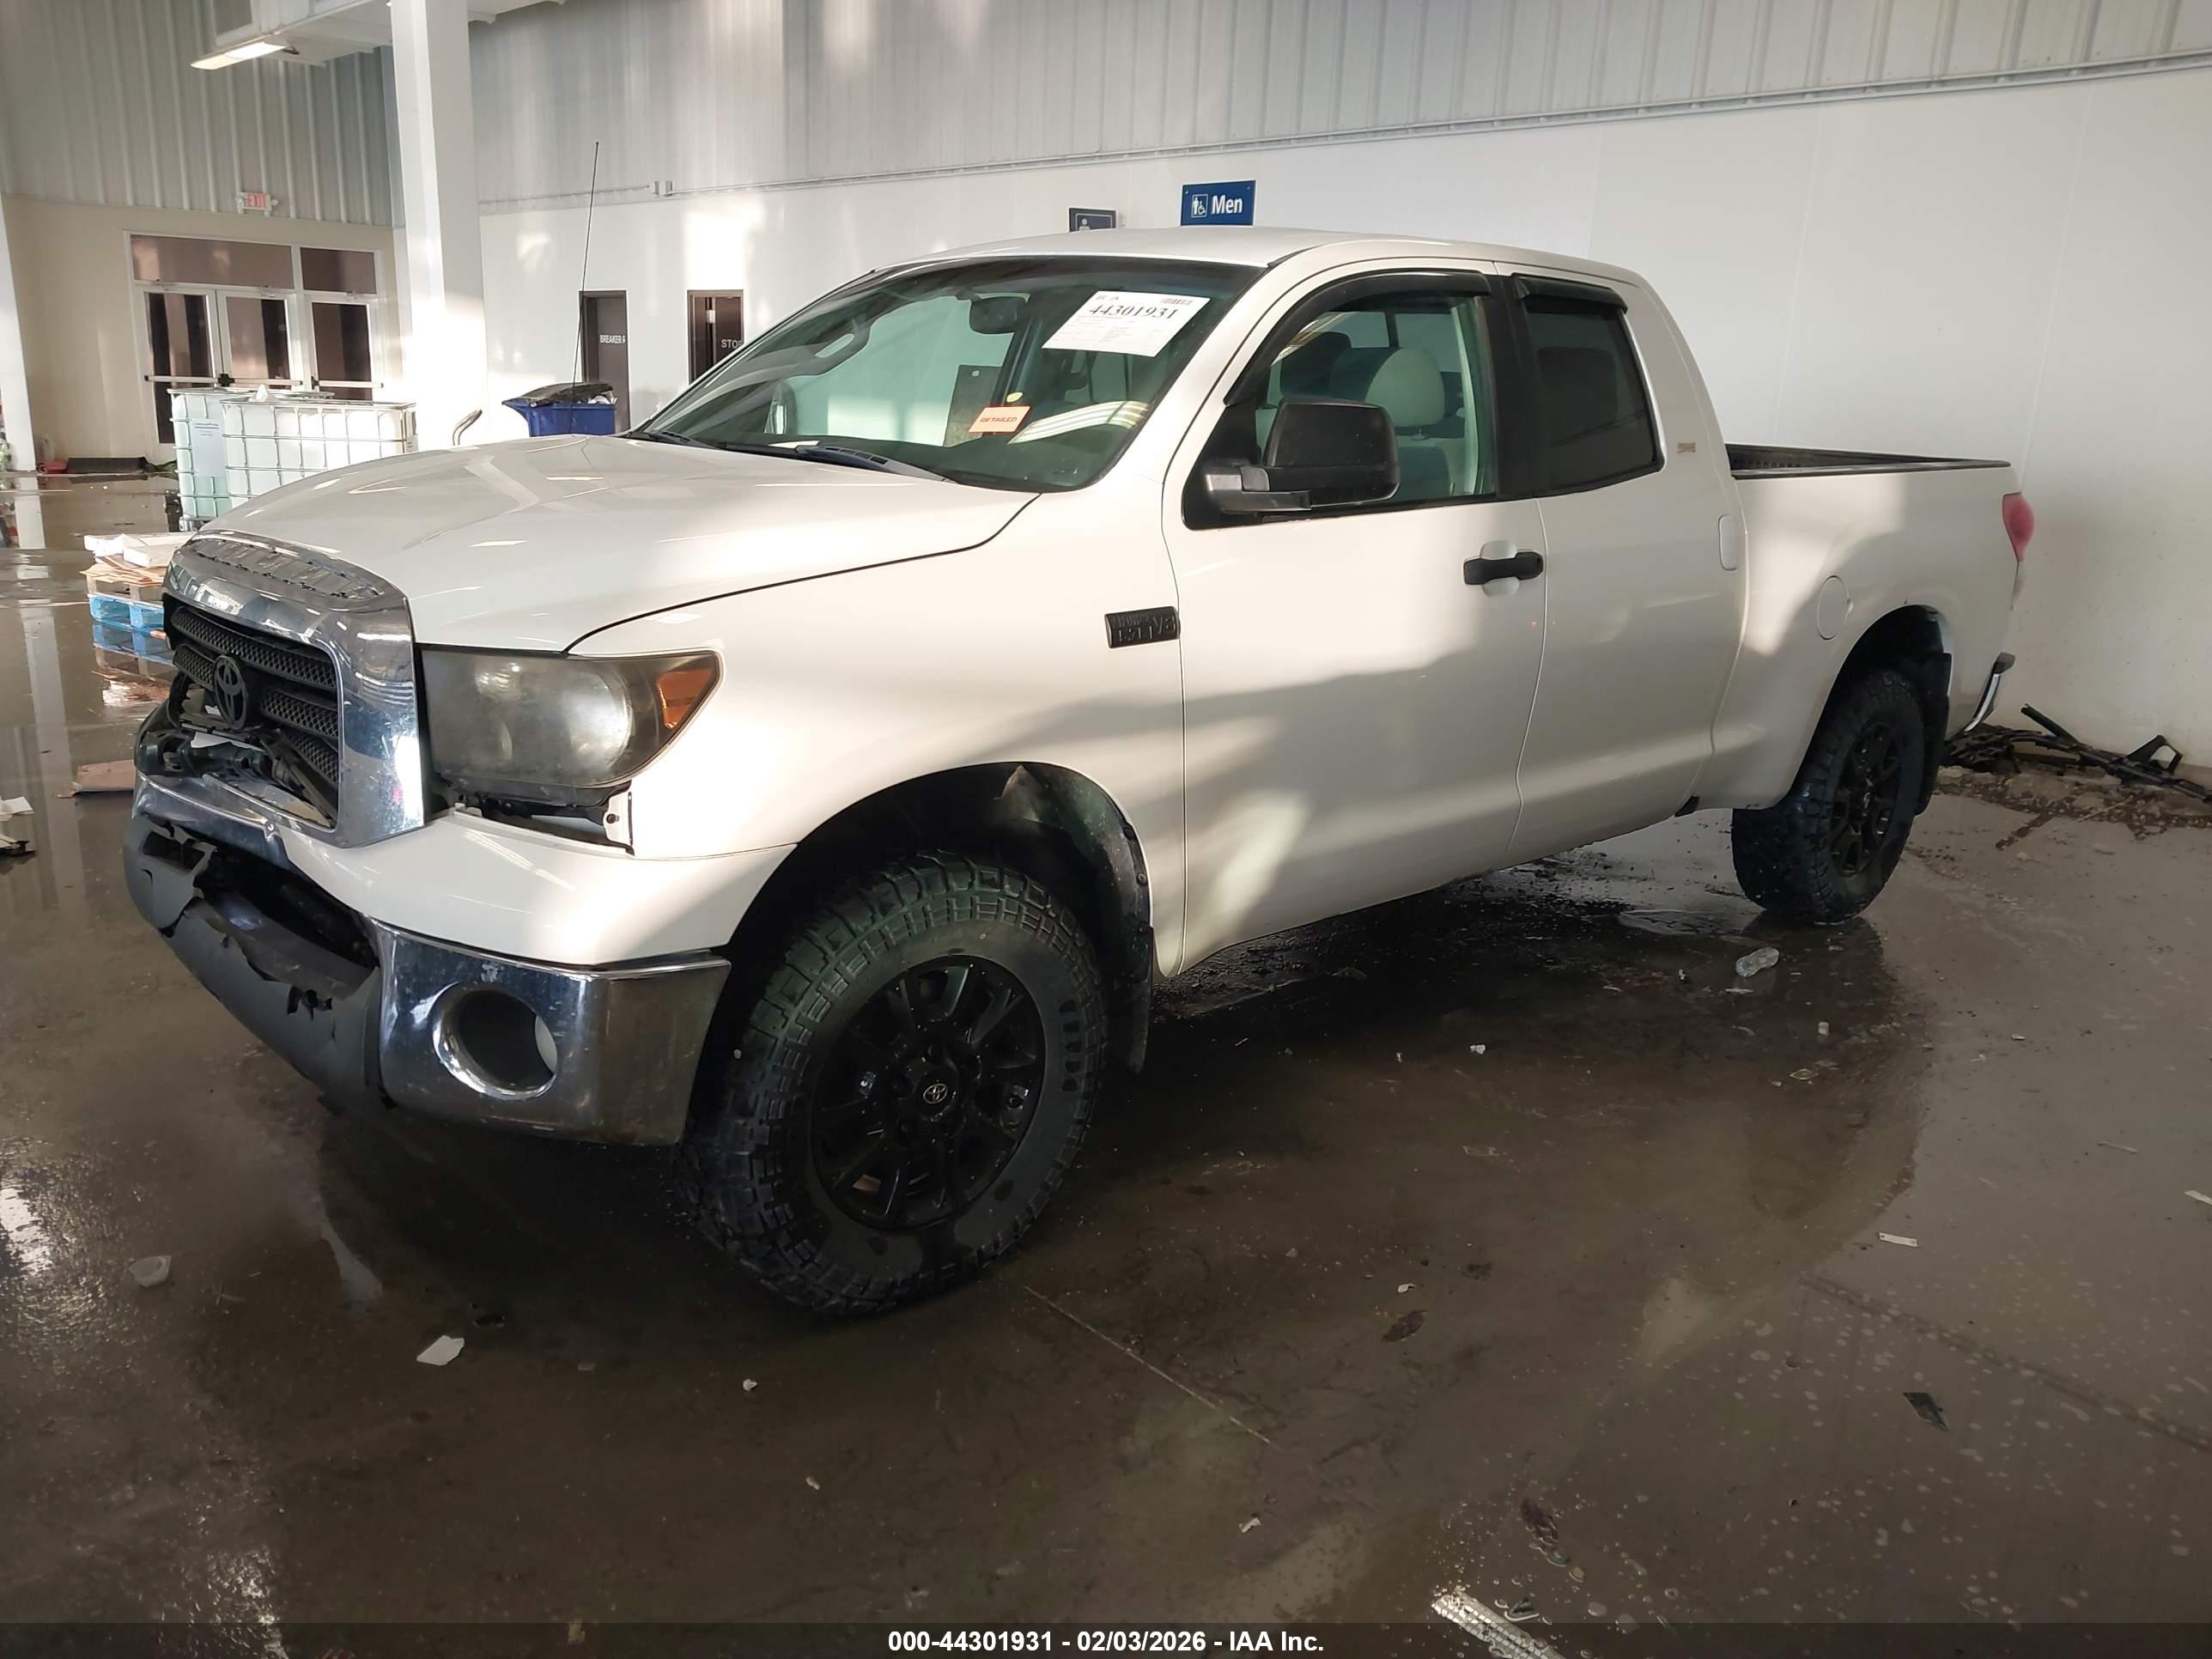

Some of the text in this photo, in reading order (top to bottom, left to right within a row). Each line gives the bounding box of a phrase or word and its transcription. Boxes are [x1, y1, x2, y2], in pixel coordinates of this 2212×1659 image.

[1211, 194, 1243, 215] Men
[1089, 305, 1179, 319] 44301931
[599, 334, 622, 343] BREAKER
